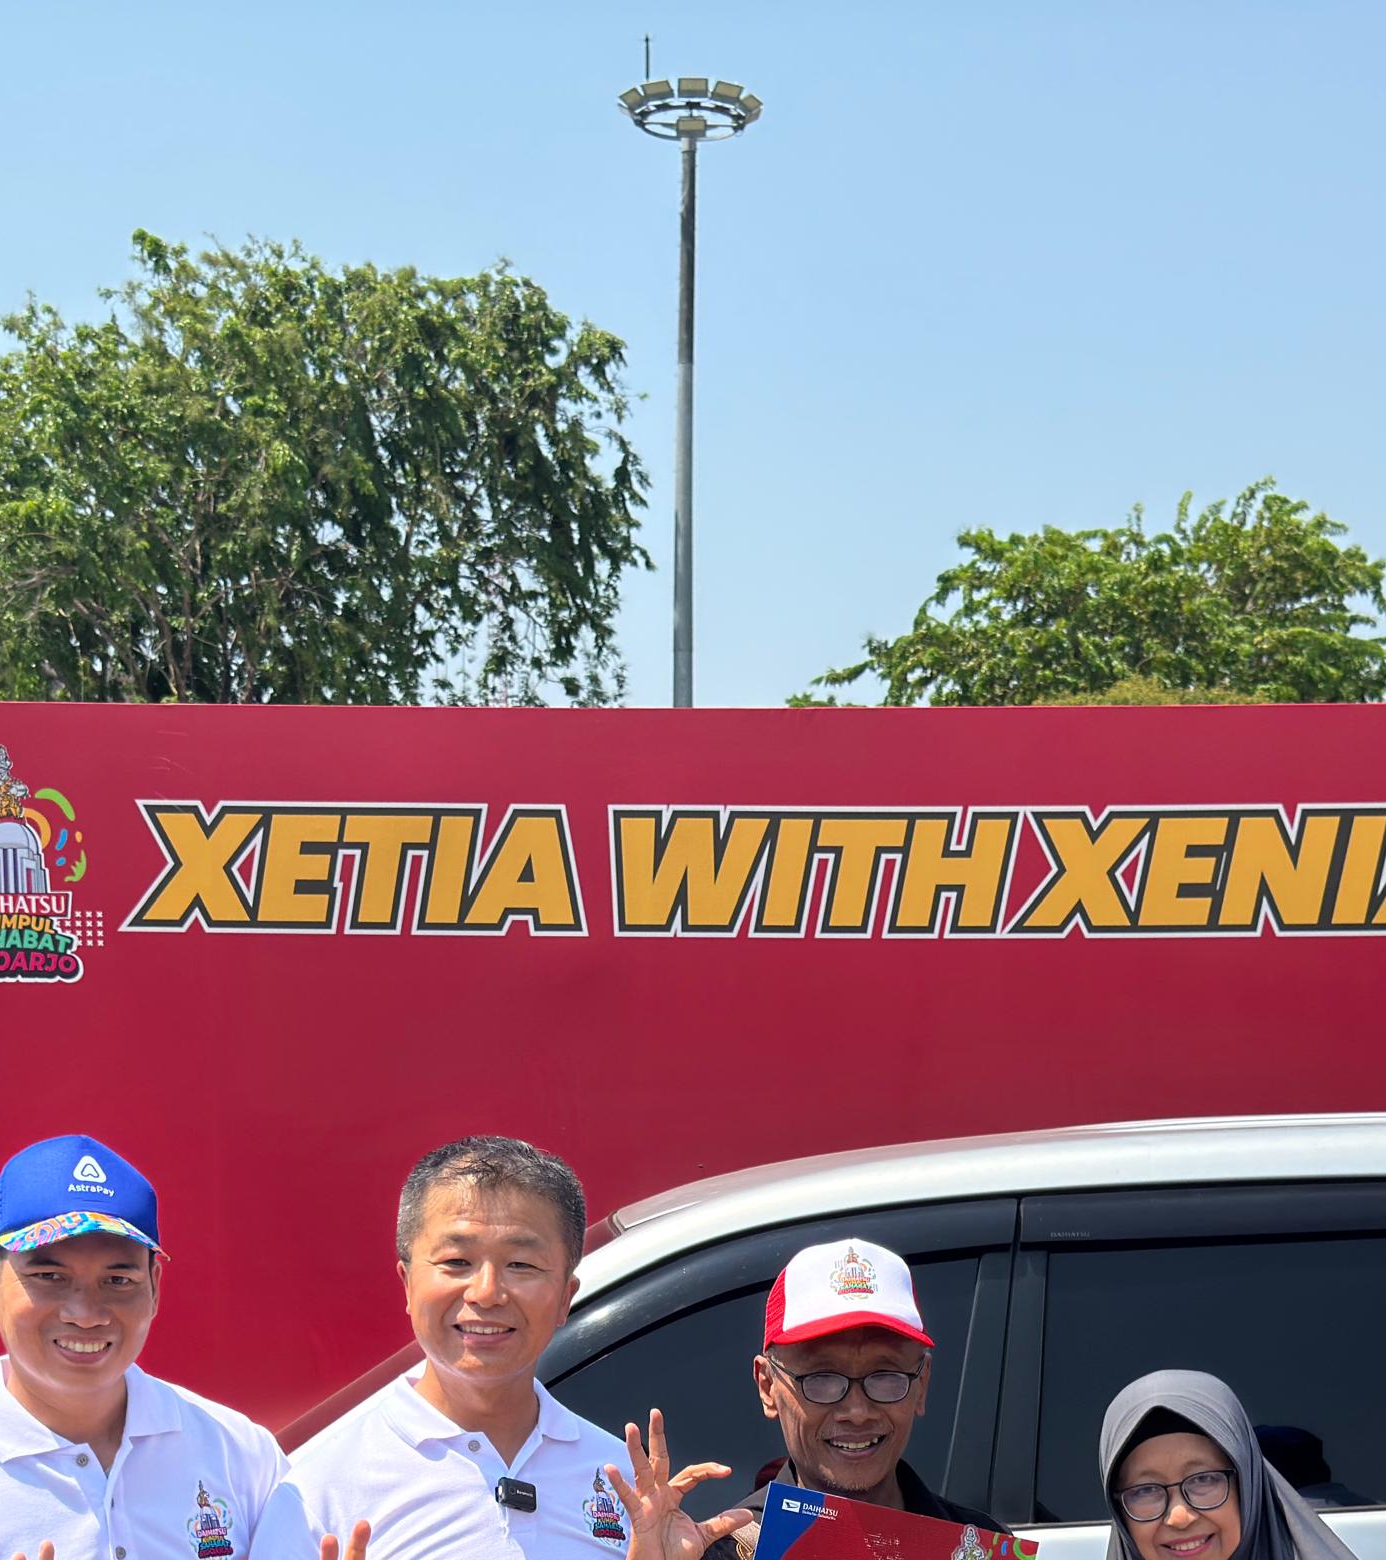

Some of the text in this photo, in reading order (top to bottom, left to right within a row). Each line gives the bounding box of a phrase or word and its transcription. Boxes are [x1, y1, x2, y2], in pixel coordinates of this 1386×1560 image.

[118, 800, 589, 935] XETIA
[608, 804, 1025, 938] WITH
[68, 1183, 115, 1197] AstraPay
[803, 1503, 839, 1517] DAIHATSU
